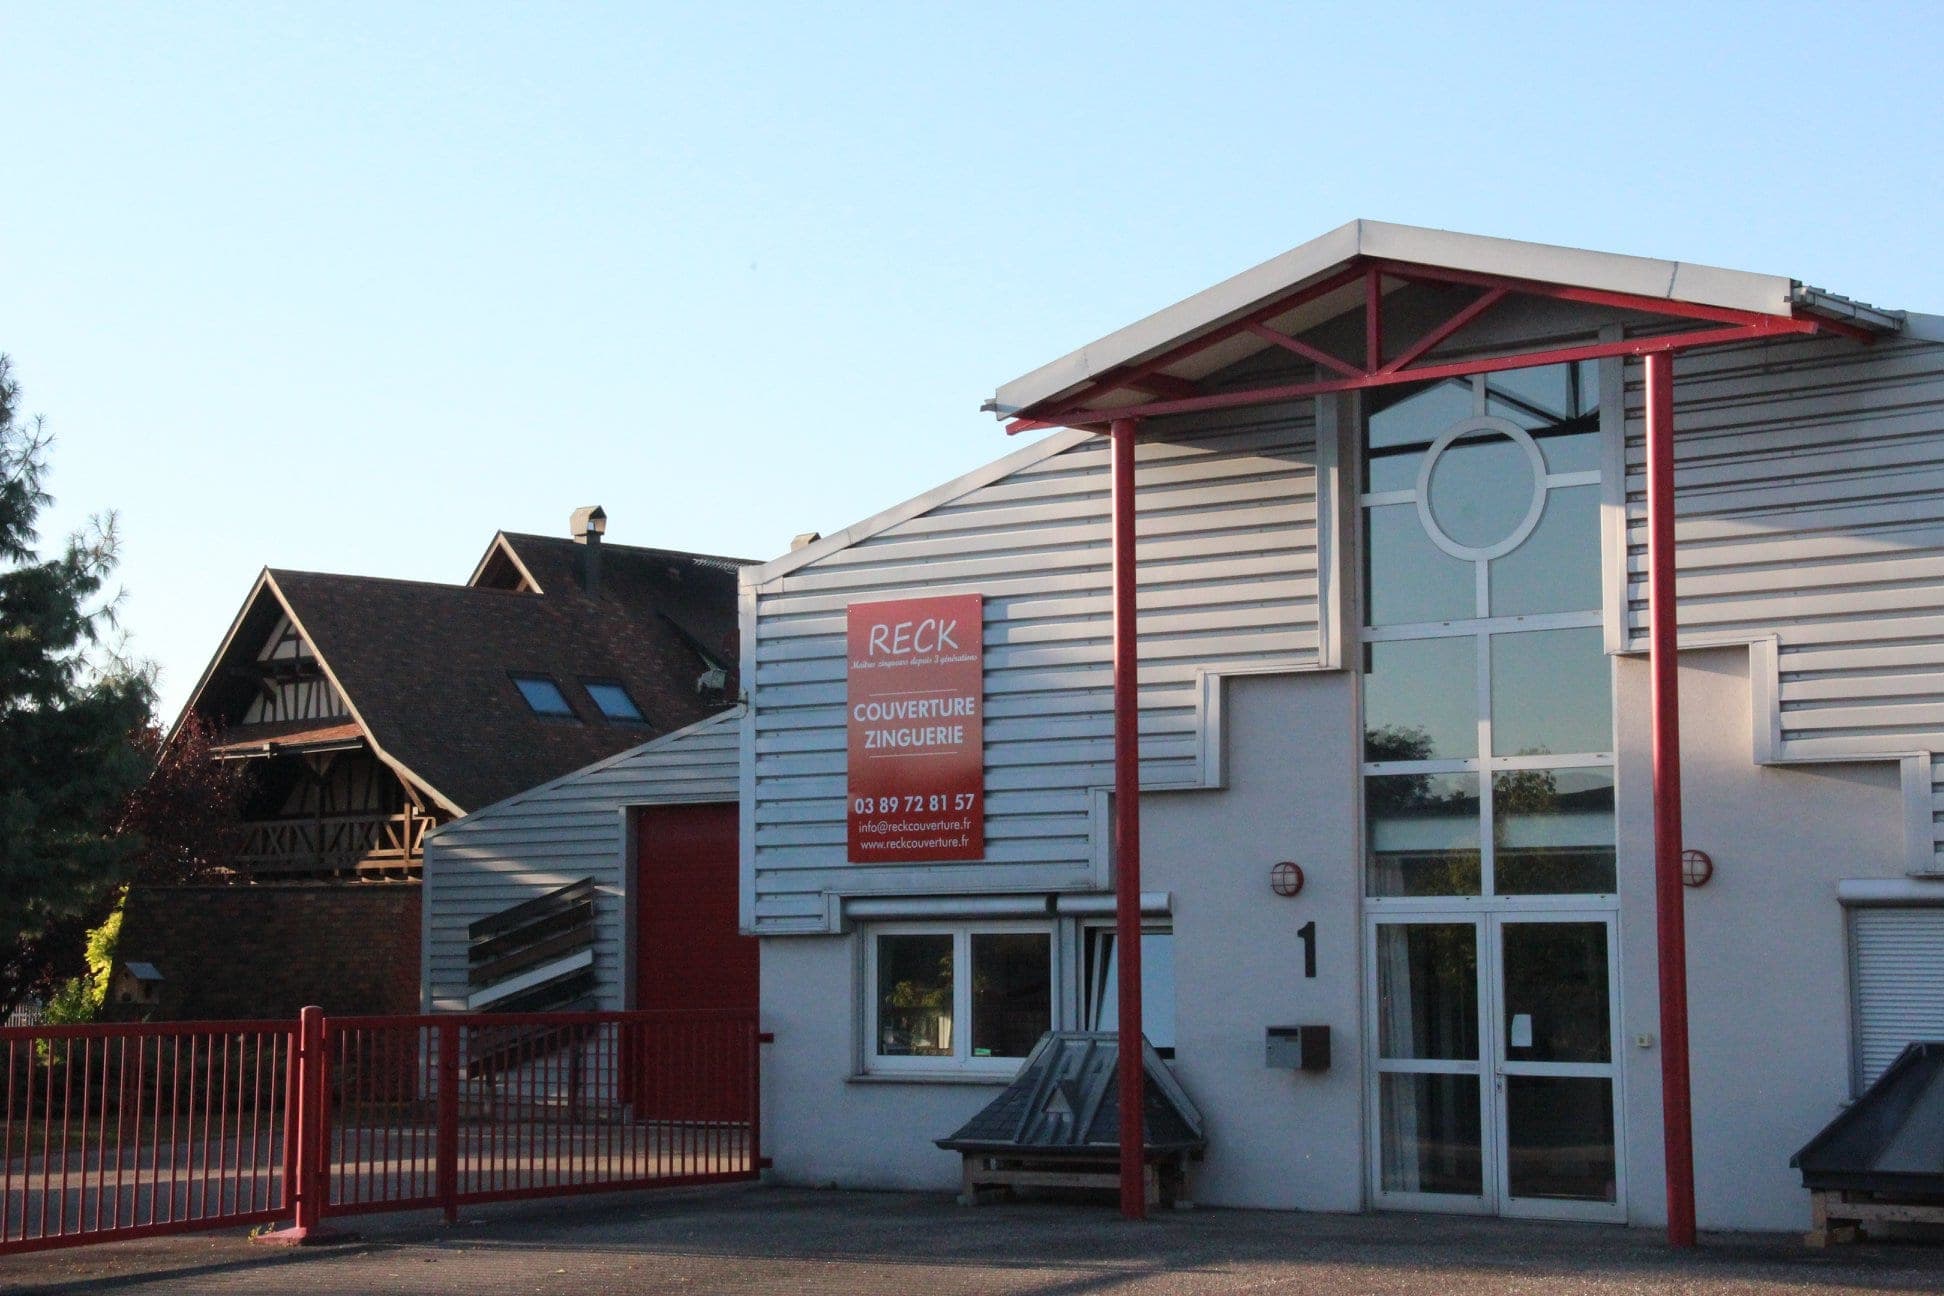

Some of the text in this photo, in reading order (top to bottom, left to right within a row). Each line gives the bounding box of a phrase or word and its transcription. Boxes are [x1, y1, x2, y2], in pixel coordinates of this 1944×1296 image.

[869, 619, 958, 656] RECK
[853, 697, 975, 721] COUVERTURE
[864, 726, 963, 749] ZINGUERIE
[855, 794, 975, 814] 03 89 72 81 57
[858, 817, 971, 834] info@reckcouverture.fr
[860, 835, 969, 850] www.reckcouverture.fr
[1297, 921, 1316, 978] 1
